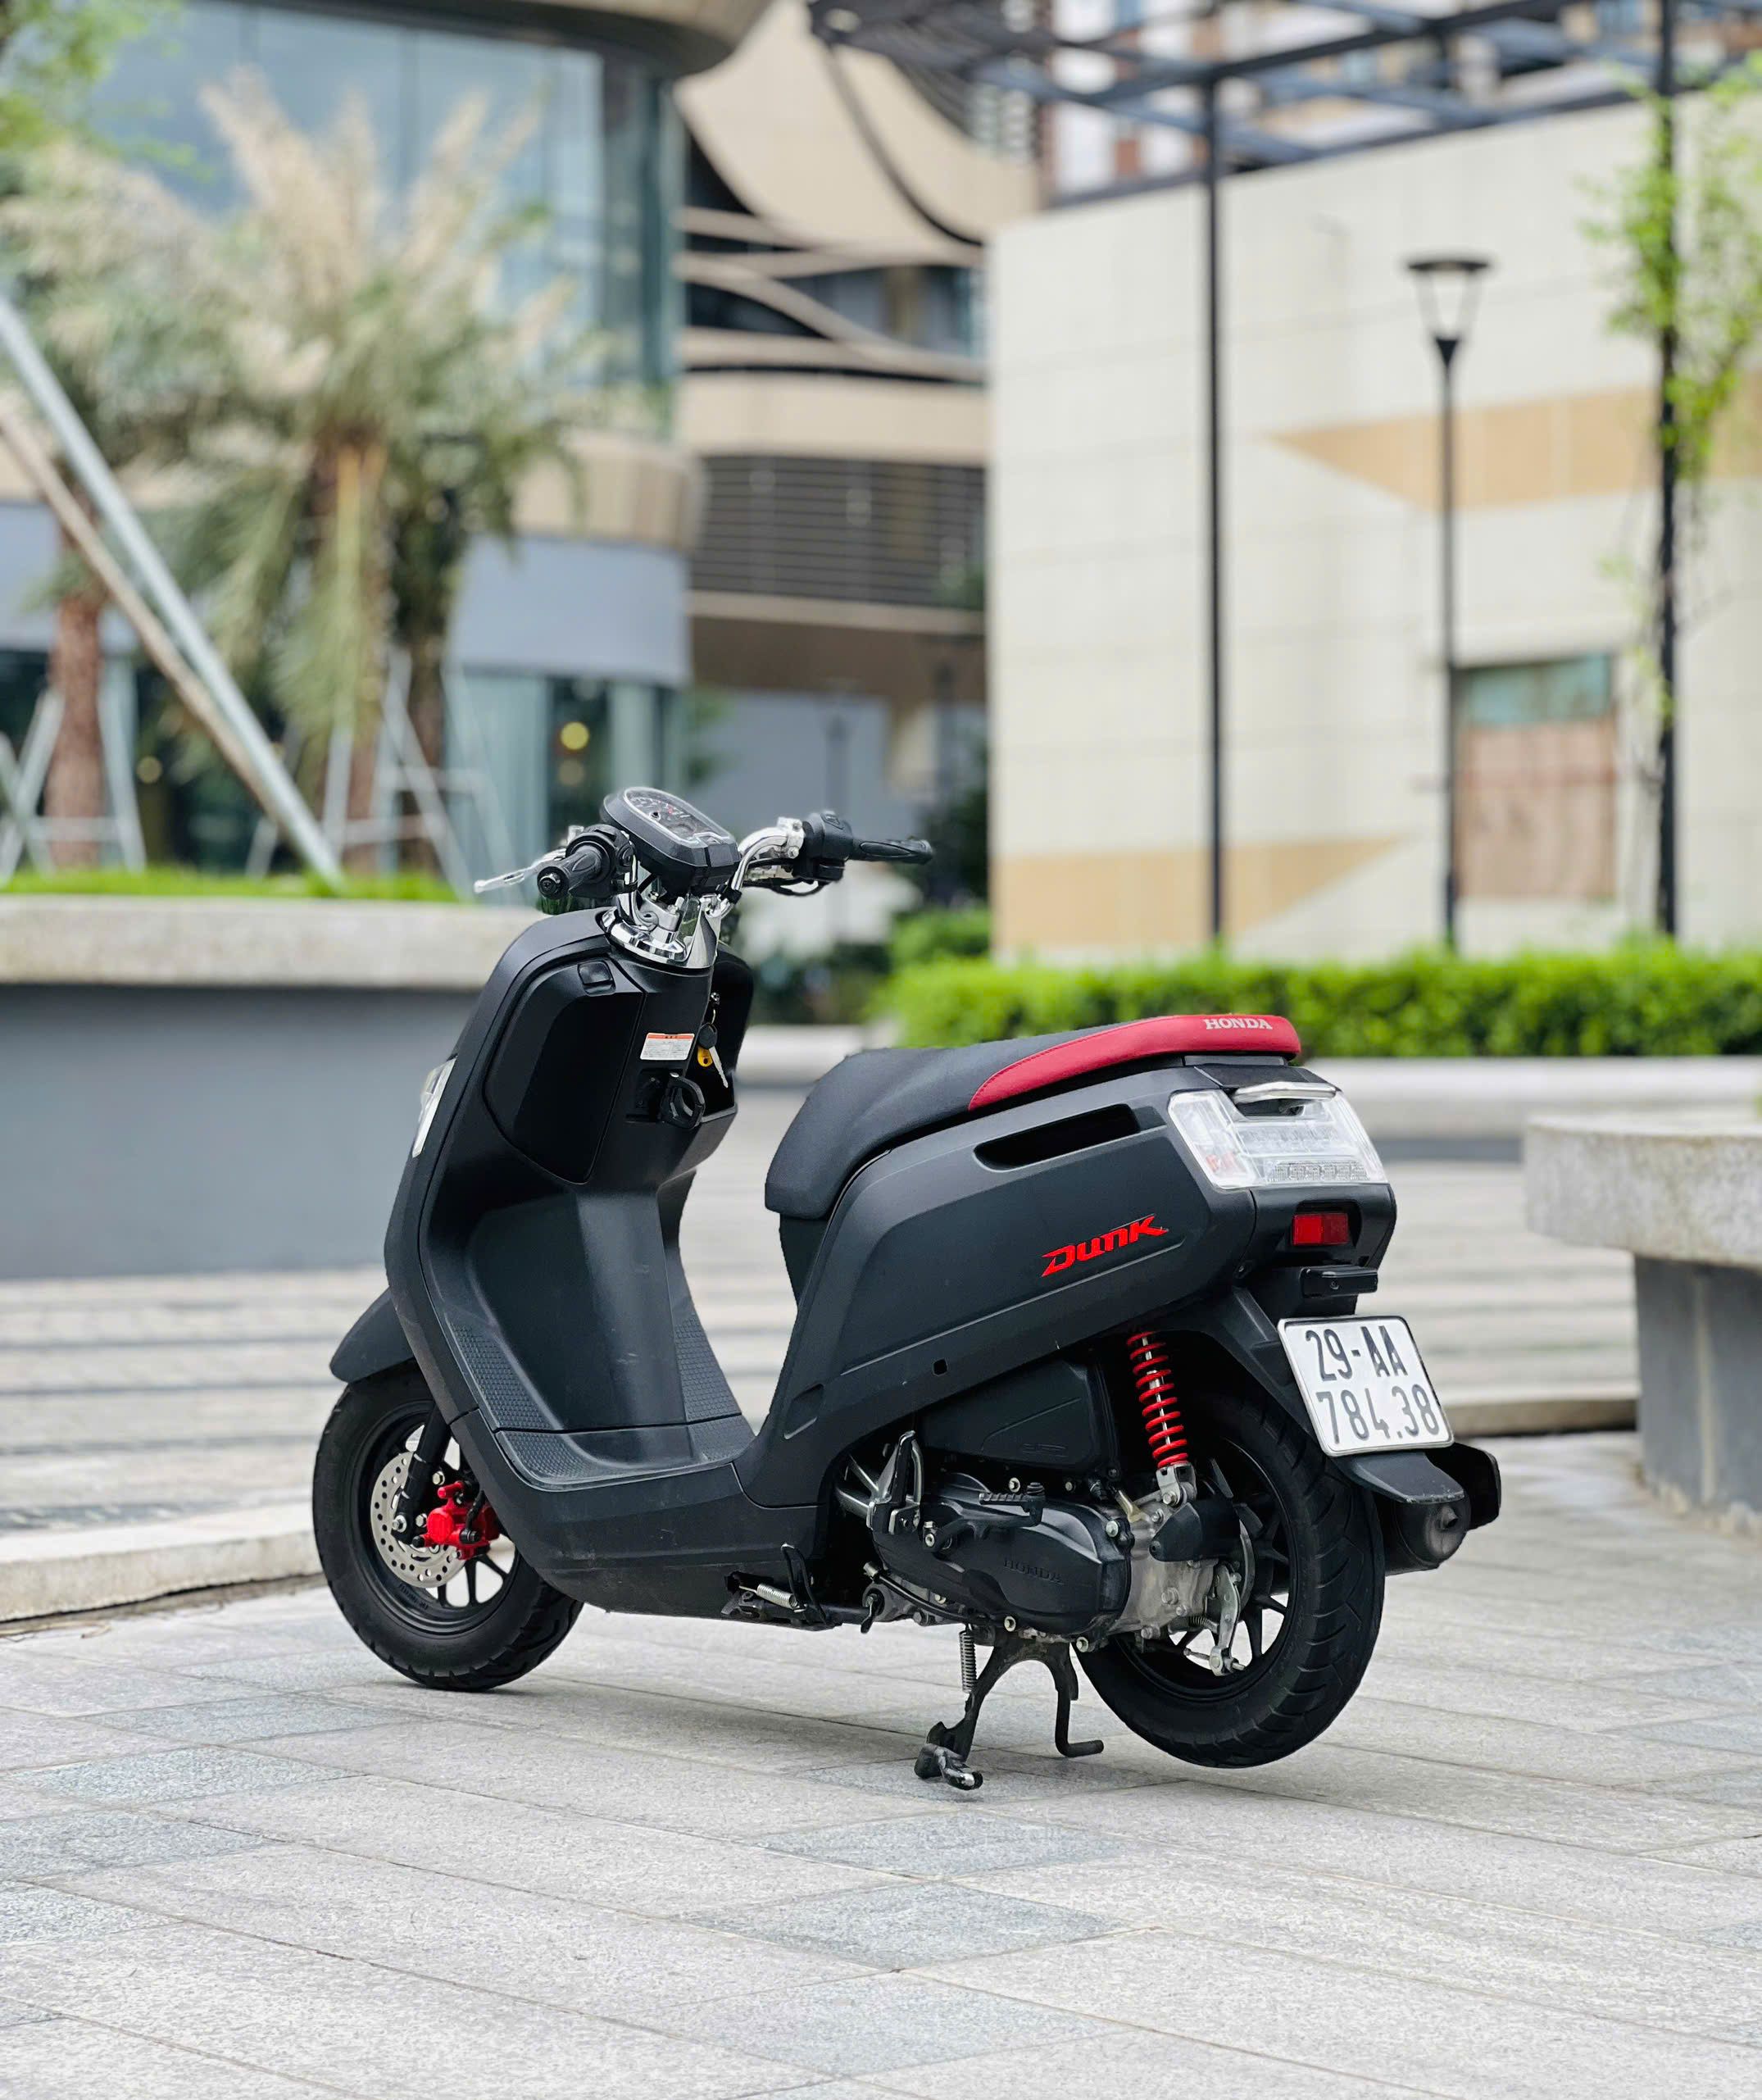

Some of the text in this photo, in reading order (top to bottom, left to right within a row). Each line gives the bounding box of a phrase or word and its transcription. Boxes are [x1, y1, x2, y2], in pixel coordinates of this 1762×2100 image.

[1203, 1017, 1273, 1030] HONDA
[1306, 1325, 1408, 1381] 29-AA
[1315, 1384, 1440, 1444] 784.38
